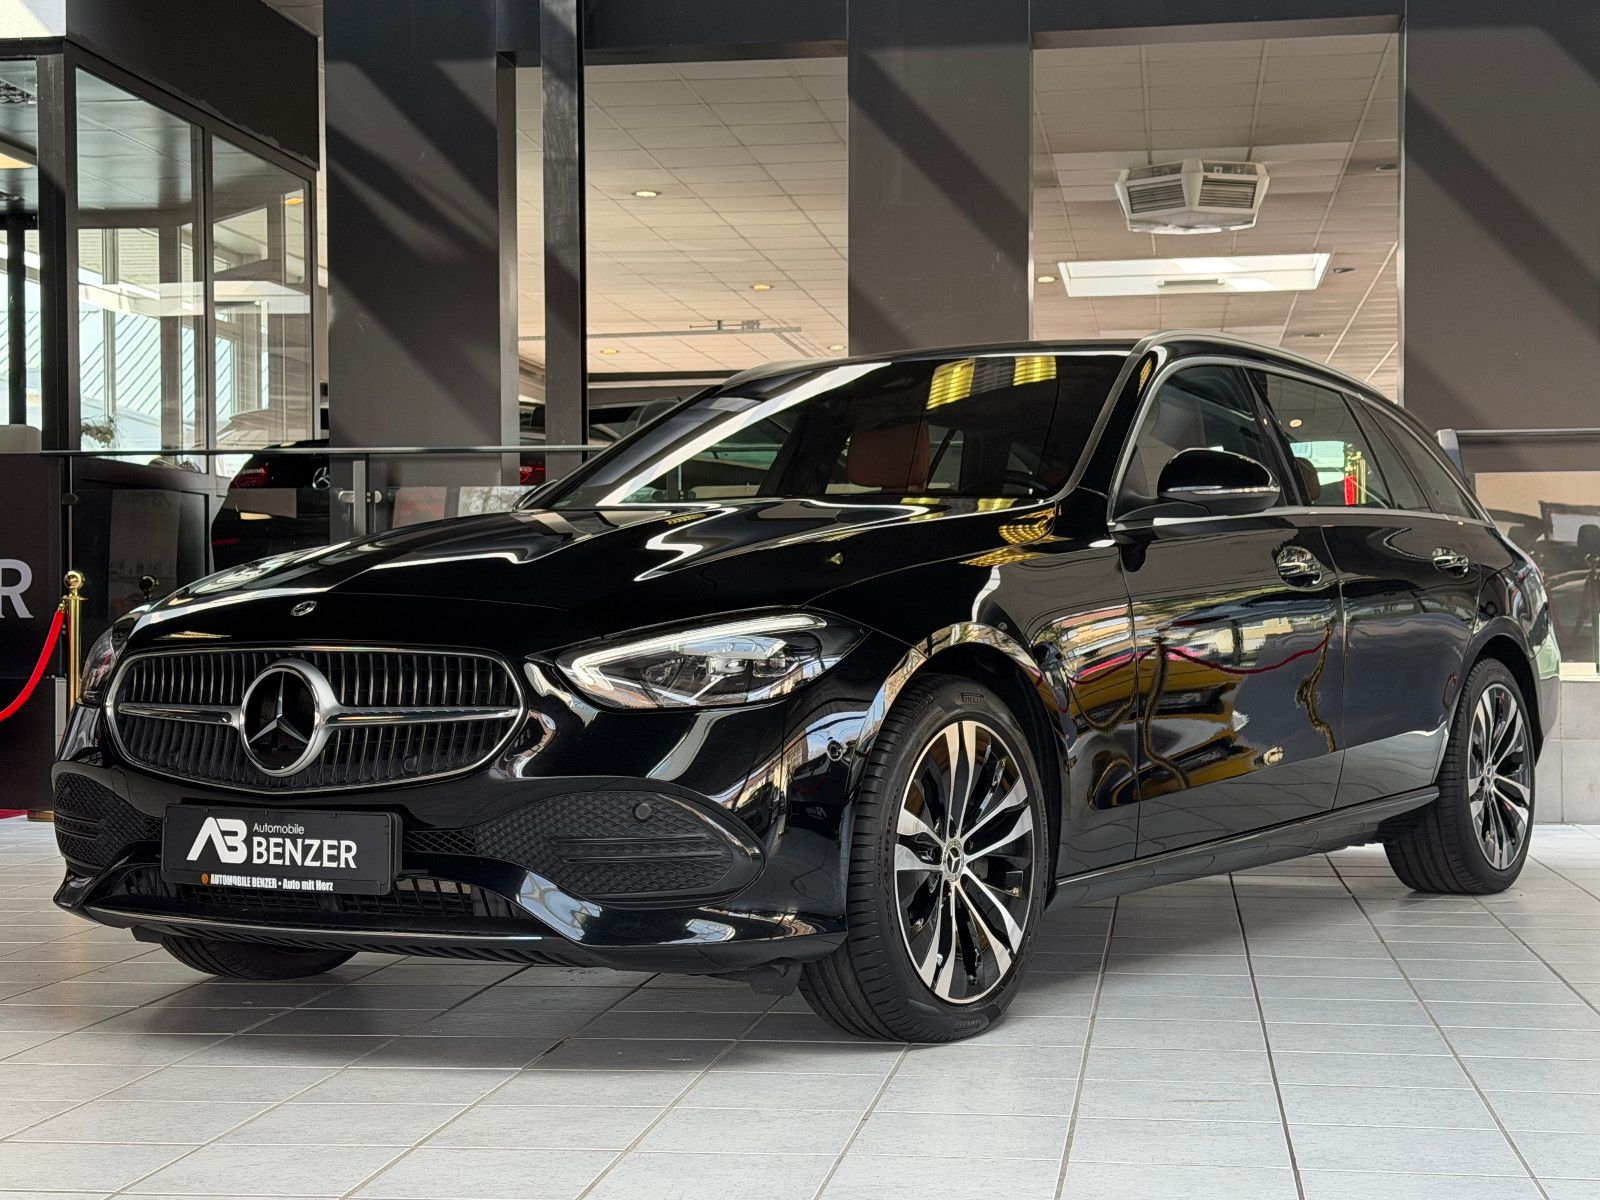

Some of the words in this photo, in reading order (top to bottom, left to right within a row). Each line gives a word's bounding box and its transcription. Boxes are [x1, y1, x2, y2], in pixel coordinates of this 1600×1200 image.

[0, 558, 34, 619] R
[252, 822, 305, 835] Automobile
[252, 836, 358, 869] BENZER
[210, 873, 251, 888] AUTOMOBILE
[251, 876, 278, 889] BENZER
[282, 878, 300, 890] Auto
[301, 879, 315, 891] mit
[315, 880, 334, 892] Herz
